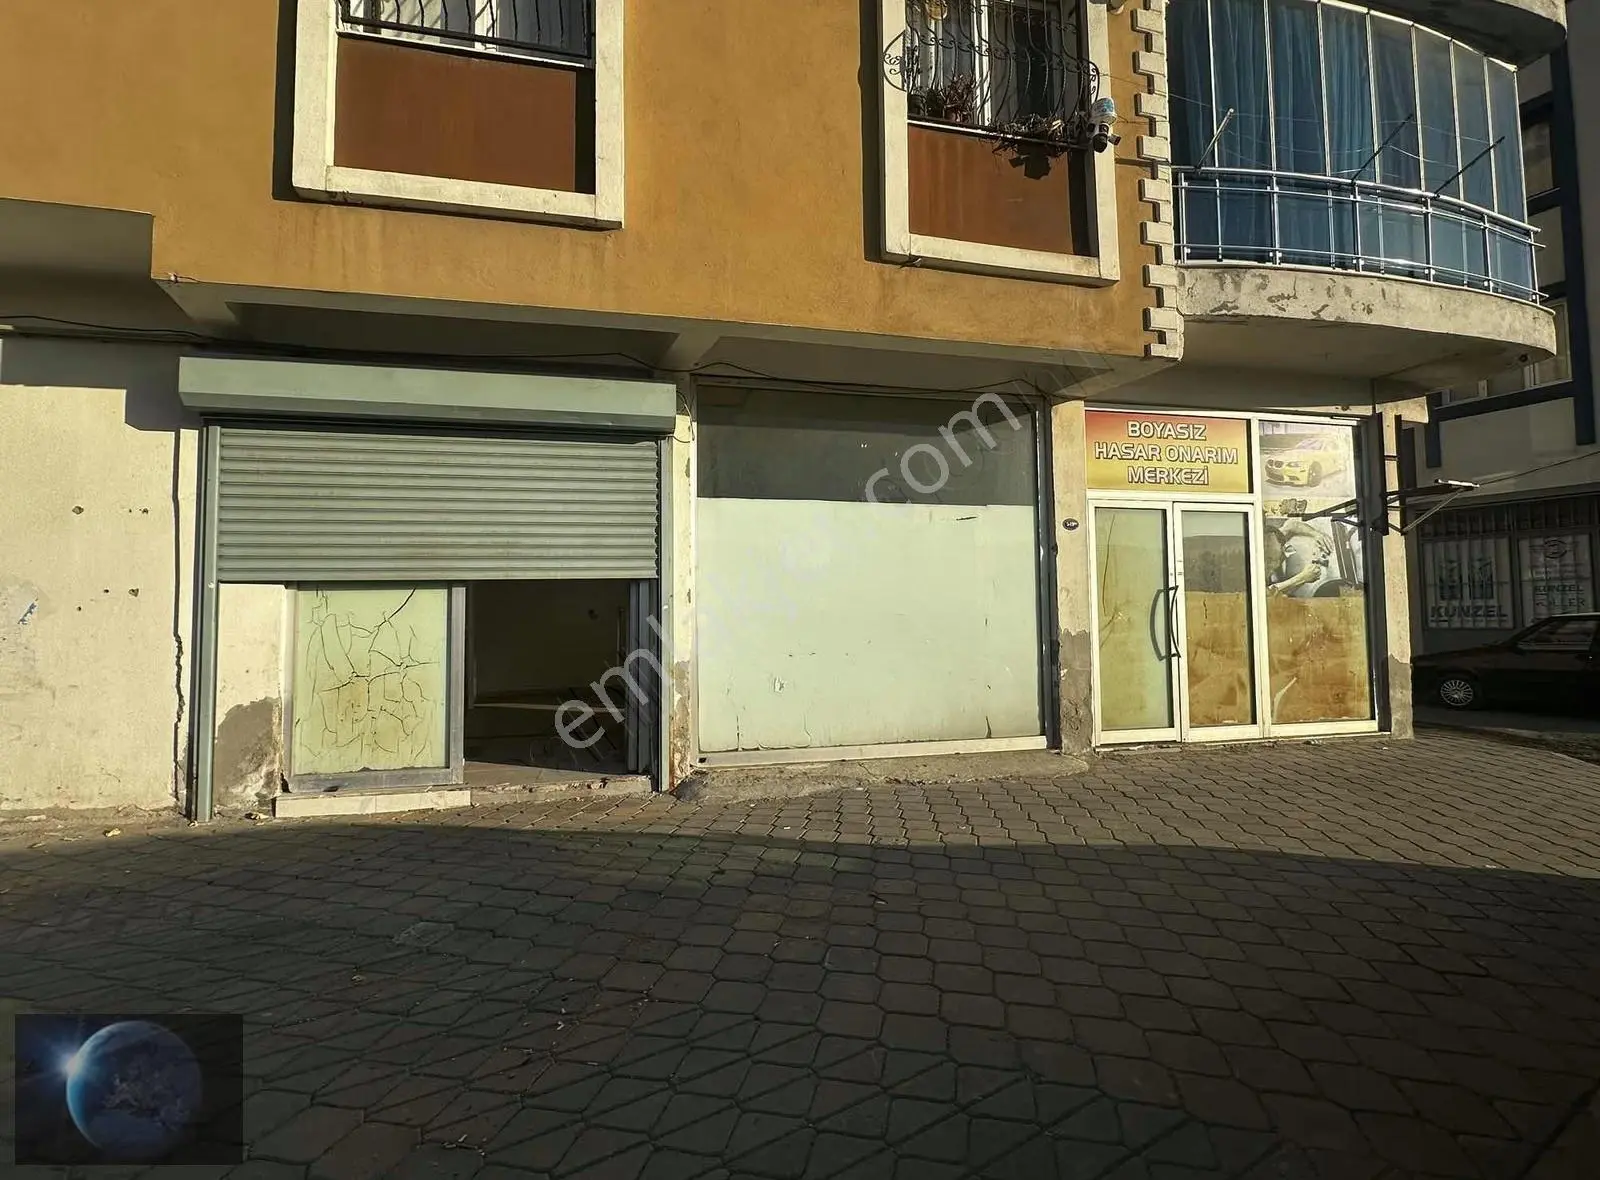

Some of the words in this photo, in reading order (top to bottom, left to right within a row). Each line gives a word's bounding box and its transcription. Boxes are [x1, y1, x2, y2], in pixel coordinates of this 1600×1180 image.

[1127, 421, 1206, 441] BOYASIZ
[1095, 442, 1161, 461] HASAR
[1165, 445, 1238, 464] ONARIM
[1127, 466, 1209, 485] MERKEZİ
